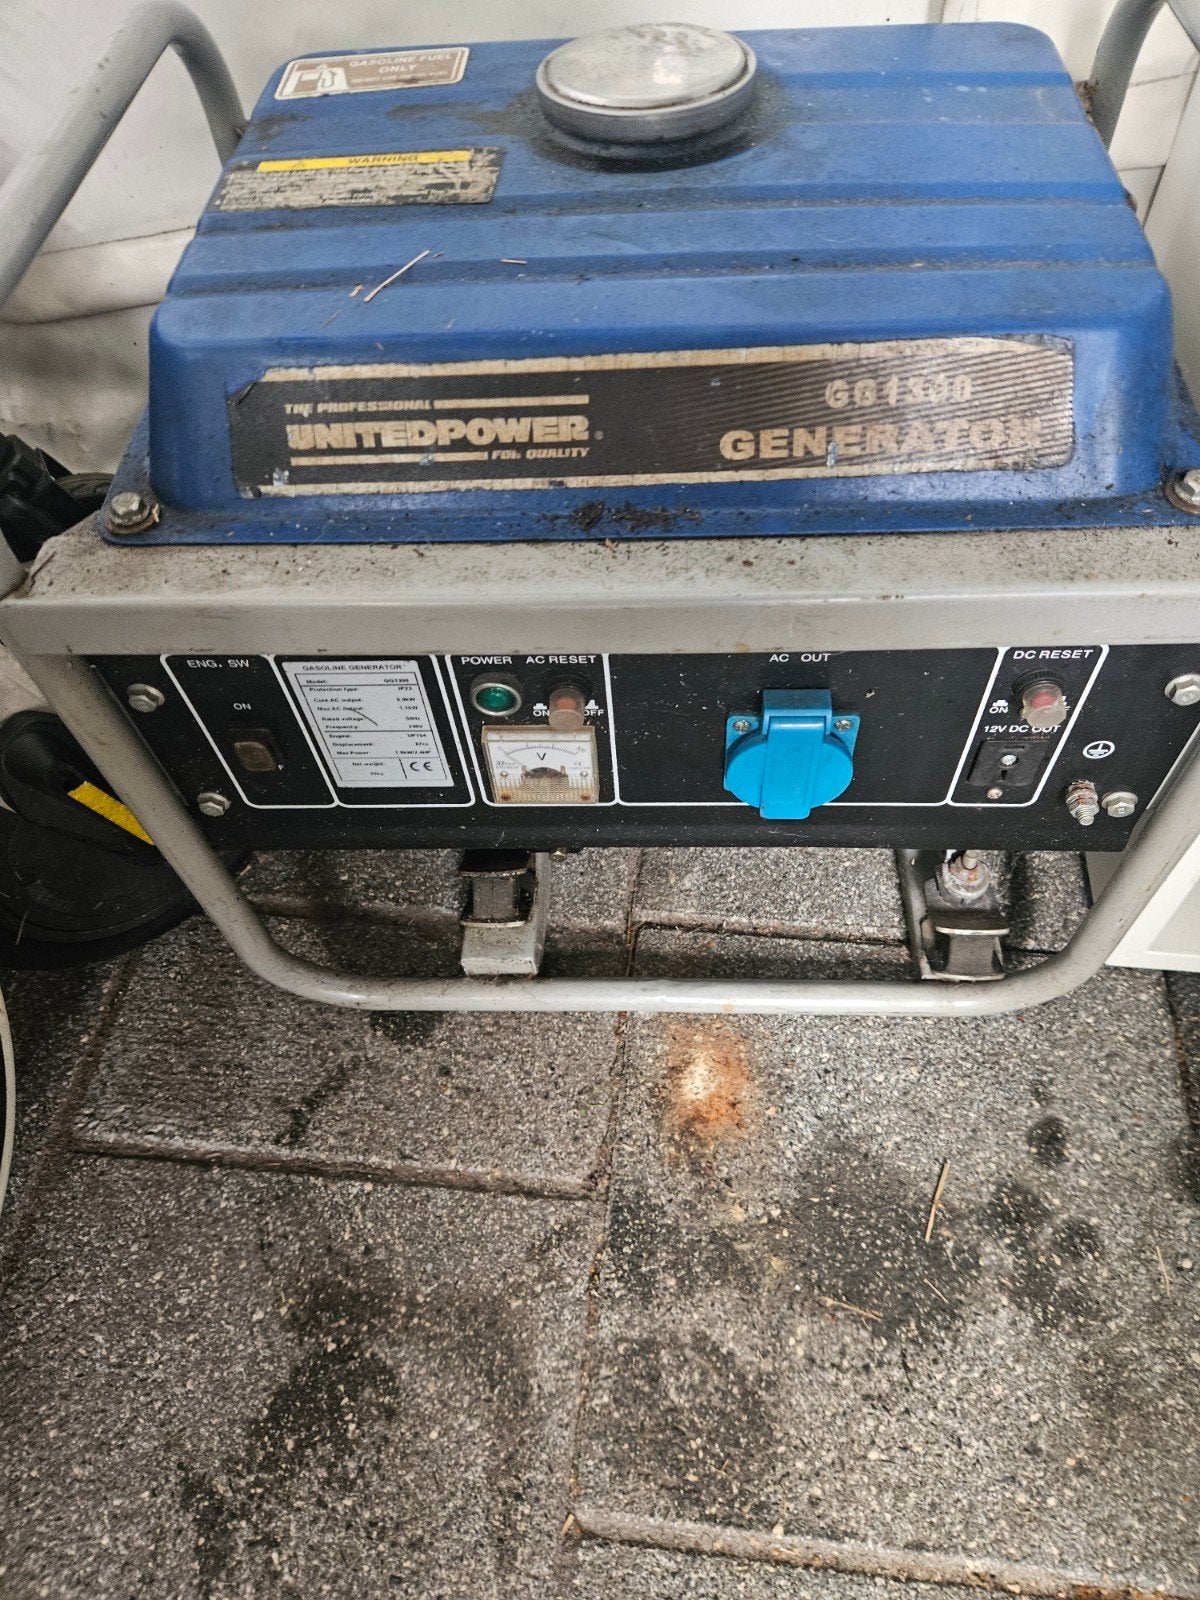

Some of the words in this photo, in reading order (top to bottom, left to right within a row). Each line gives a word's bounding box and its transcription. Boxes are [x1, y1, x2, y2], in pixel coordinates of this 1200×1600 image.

[378, 64, 417, 73] ONLY
[348, 154, 419, 165] WARNING
[317, 400, 432, 413] PROFESSIONAL
[286, 416, 590, 450] UNITEDPOWER
[719, 418, 1042, 461] GENERATOR
[526, 447, 591, 460] QUALITY
[769, 653, 790, 662] AC
[800, 653, 832, 662] OUT
[1013, 650, 1036, 659] DC
[1038, 649, 1094, 659] RESET
[186, 659, 223, 668] ENG.
[227, 659, 250, 668] SW
[461, 657, 513, 665] POWER
[526, 656, 545, 664] AC
[549, 655, 596, 664] RESET
[233, 702, 252, 710] ON
[984, 725, 1007, 733] 12V
[1009, 725, 1029, 733] DC
[1031, 725, 1061, 733] OUT
[536, 752, 547, 761] V
